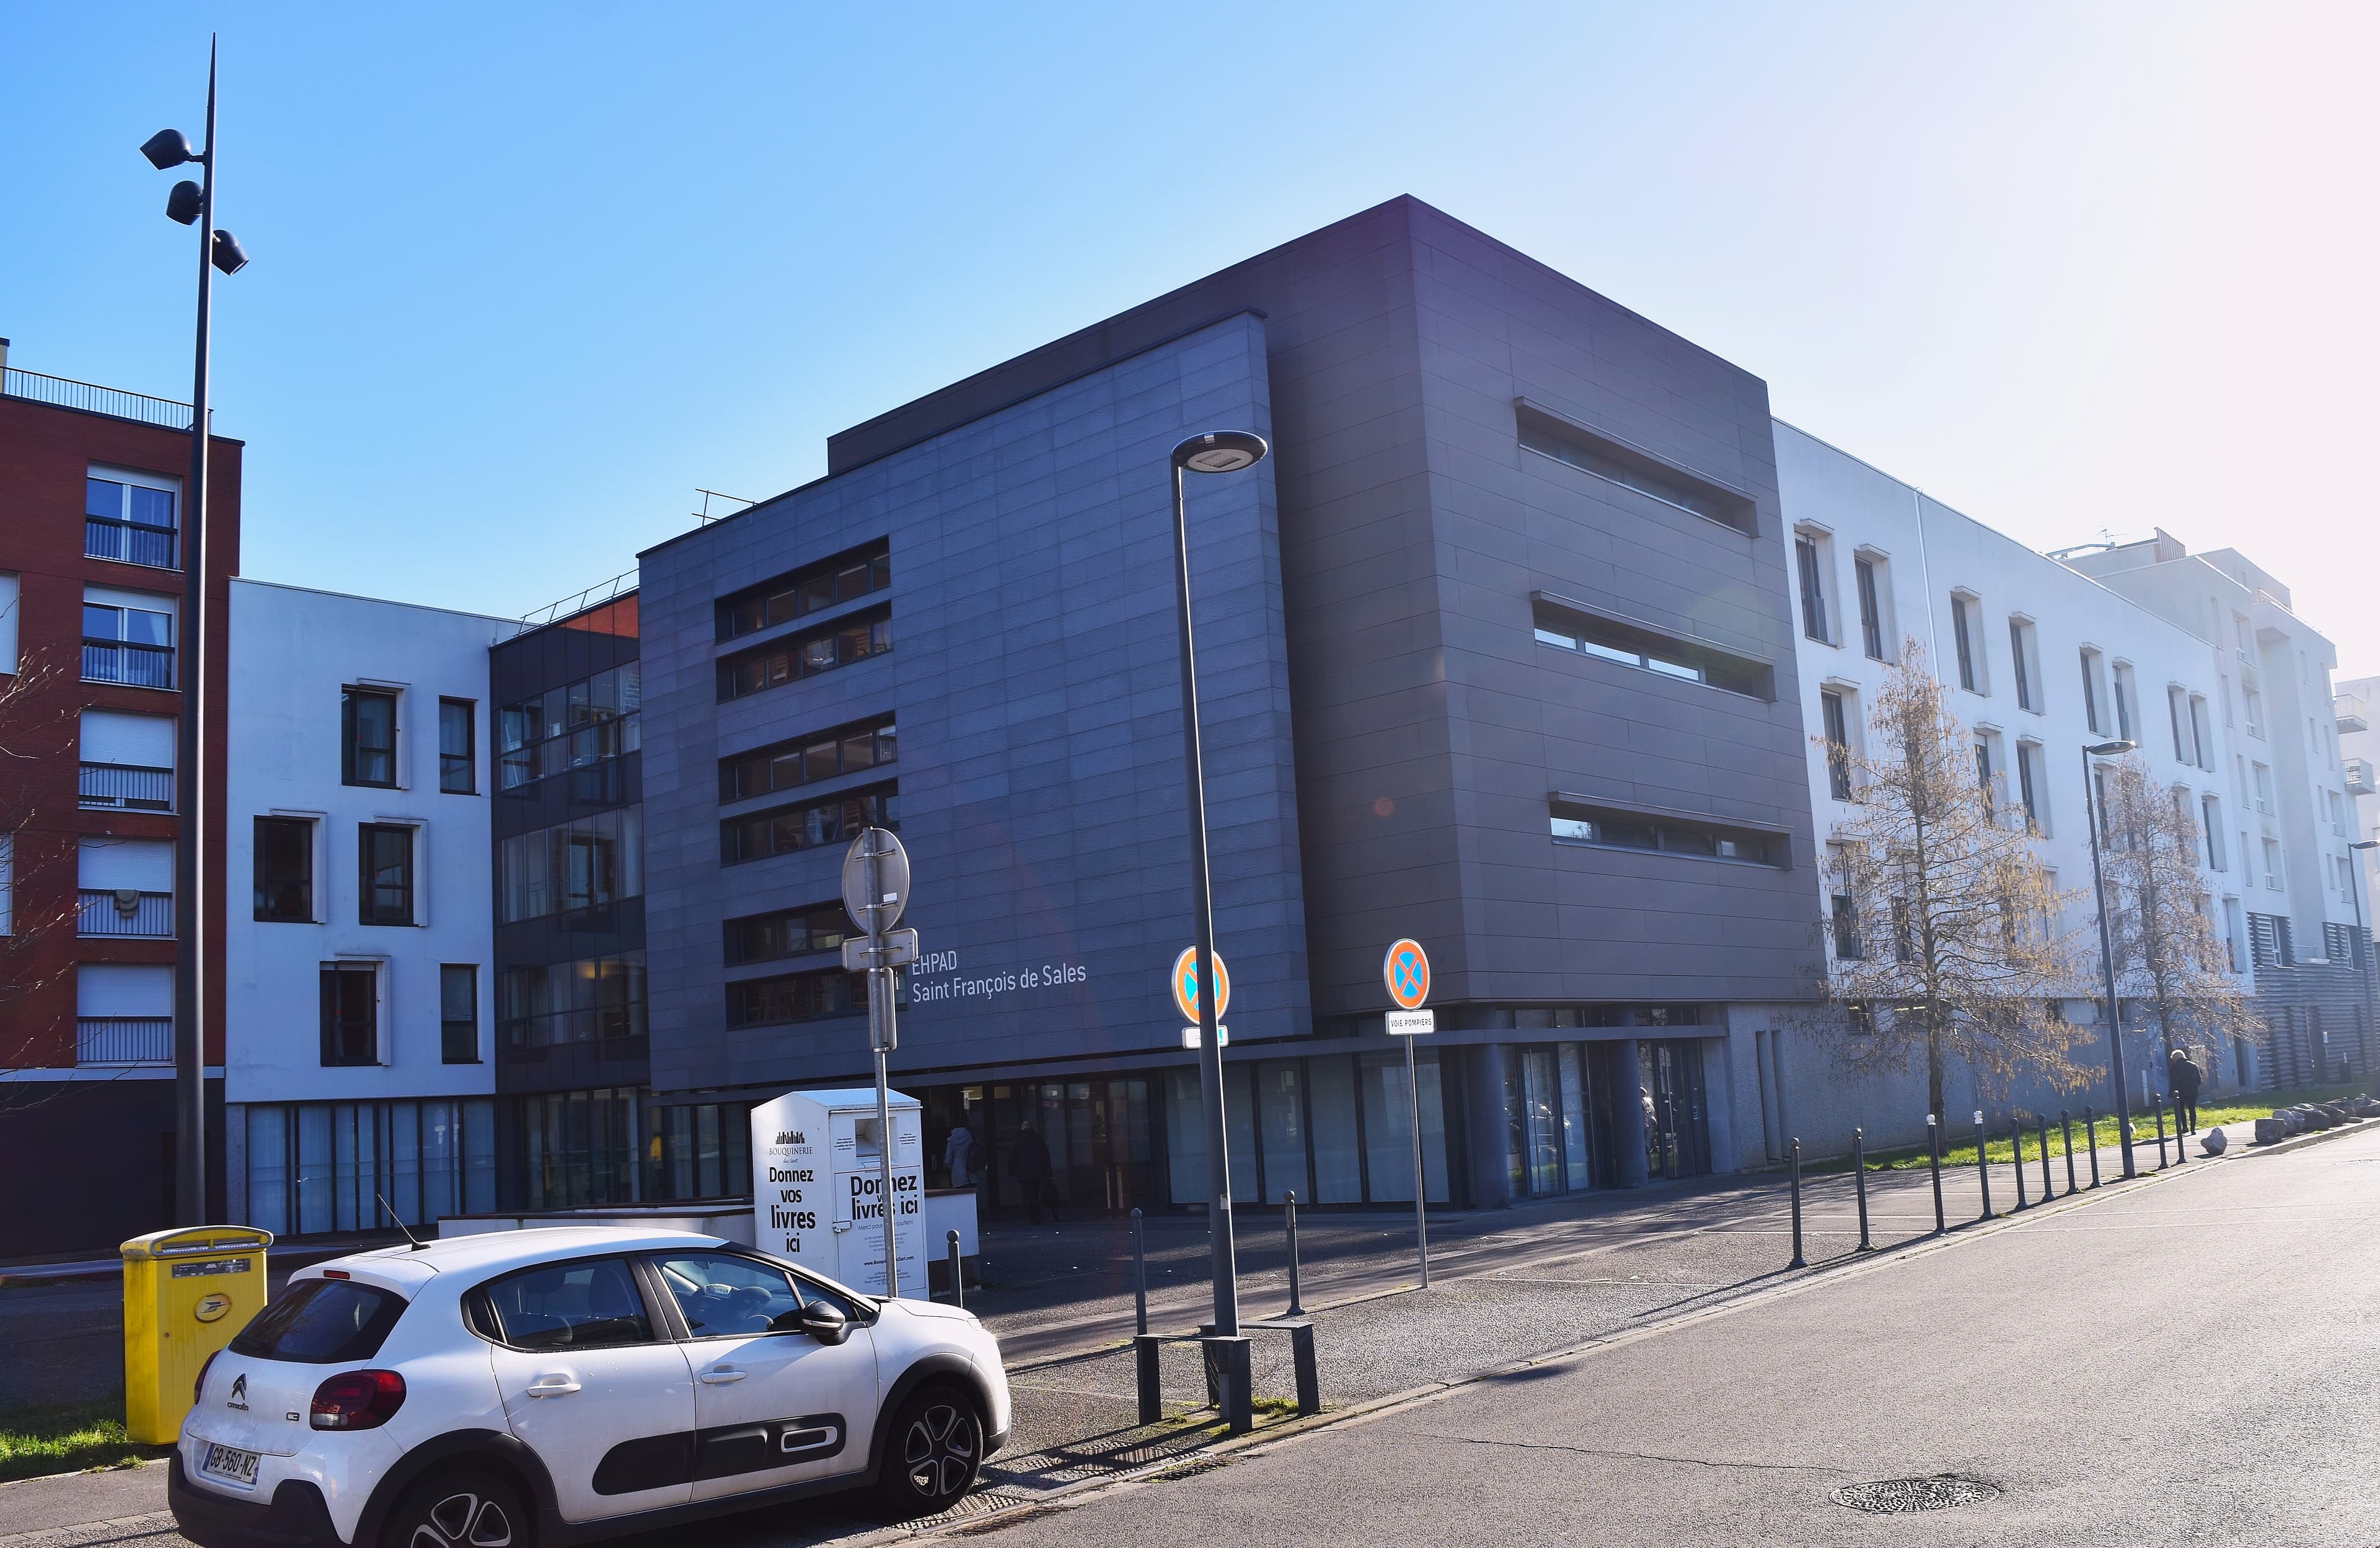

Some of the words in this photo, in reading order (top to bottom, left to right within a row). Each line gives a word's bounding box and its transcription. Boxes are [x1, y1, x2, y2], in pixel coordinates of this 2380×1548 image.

[912, 950, 957, 976] EHPAD
[913, 981, 950, 1002] Saint
[954, 971, 1016, 1000] François
[1020, 968, 1038, 989] de
[1042, 963, 1086, 986] Sales
[769, 1146, 813, 1156] BOUQUINERIE
[769, 1167, 814, 1183] Donnez
[780, 1189, 803, 1203] vos
[900, 1194, 919, 1215] ici
[770, 1205, 816, 1229] livres
[786, 1232, 800, 1253] ici
[210, 1448, 257, 1477] GB-560-NZ
